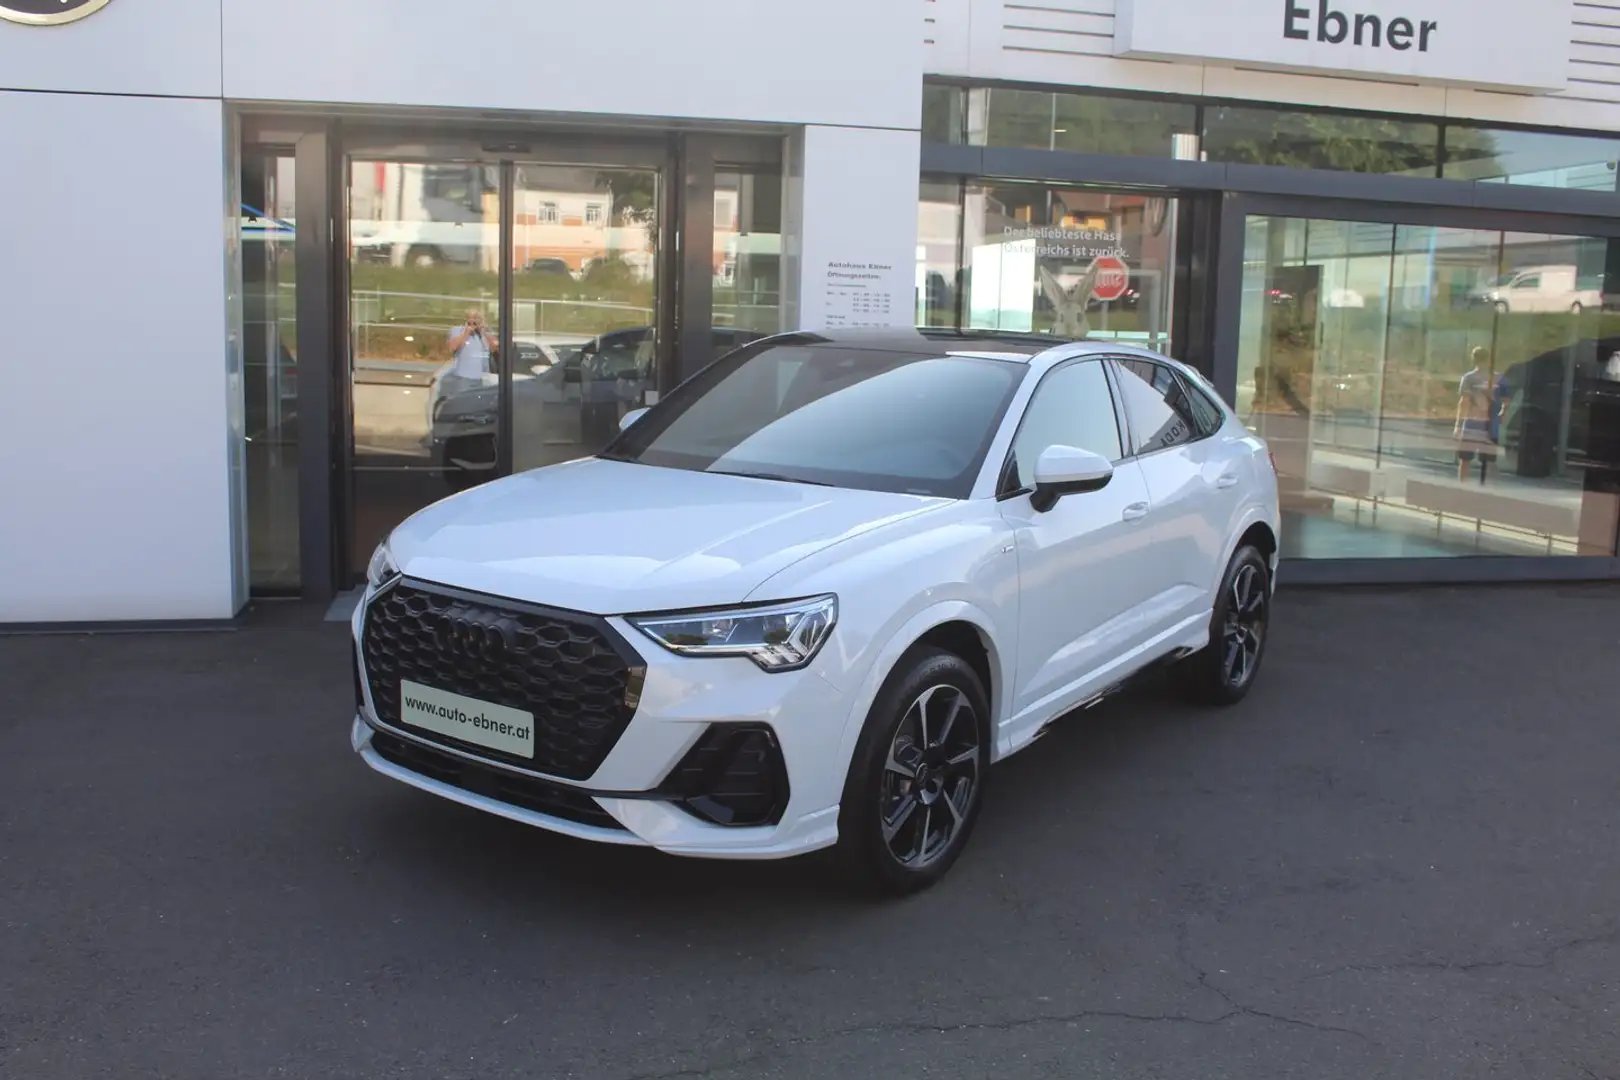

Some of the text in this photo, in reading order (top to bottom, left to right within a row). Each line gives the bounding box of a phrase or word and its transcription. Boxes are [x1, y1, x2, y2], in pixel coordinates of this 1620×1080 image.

[1284, 0, 1437, 52] Ebner
[1004, 226, 1025, 238] Der
[1026, 227, 1092, 241] beliebteste
[1072, 244, 1086, 256] ist
[1088, 245, 1130, 259] zurück.
[405, 696, 530, 740] www.auto-ebner.at
